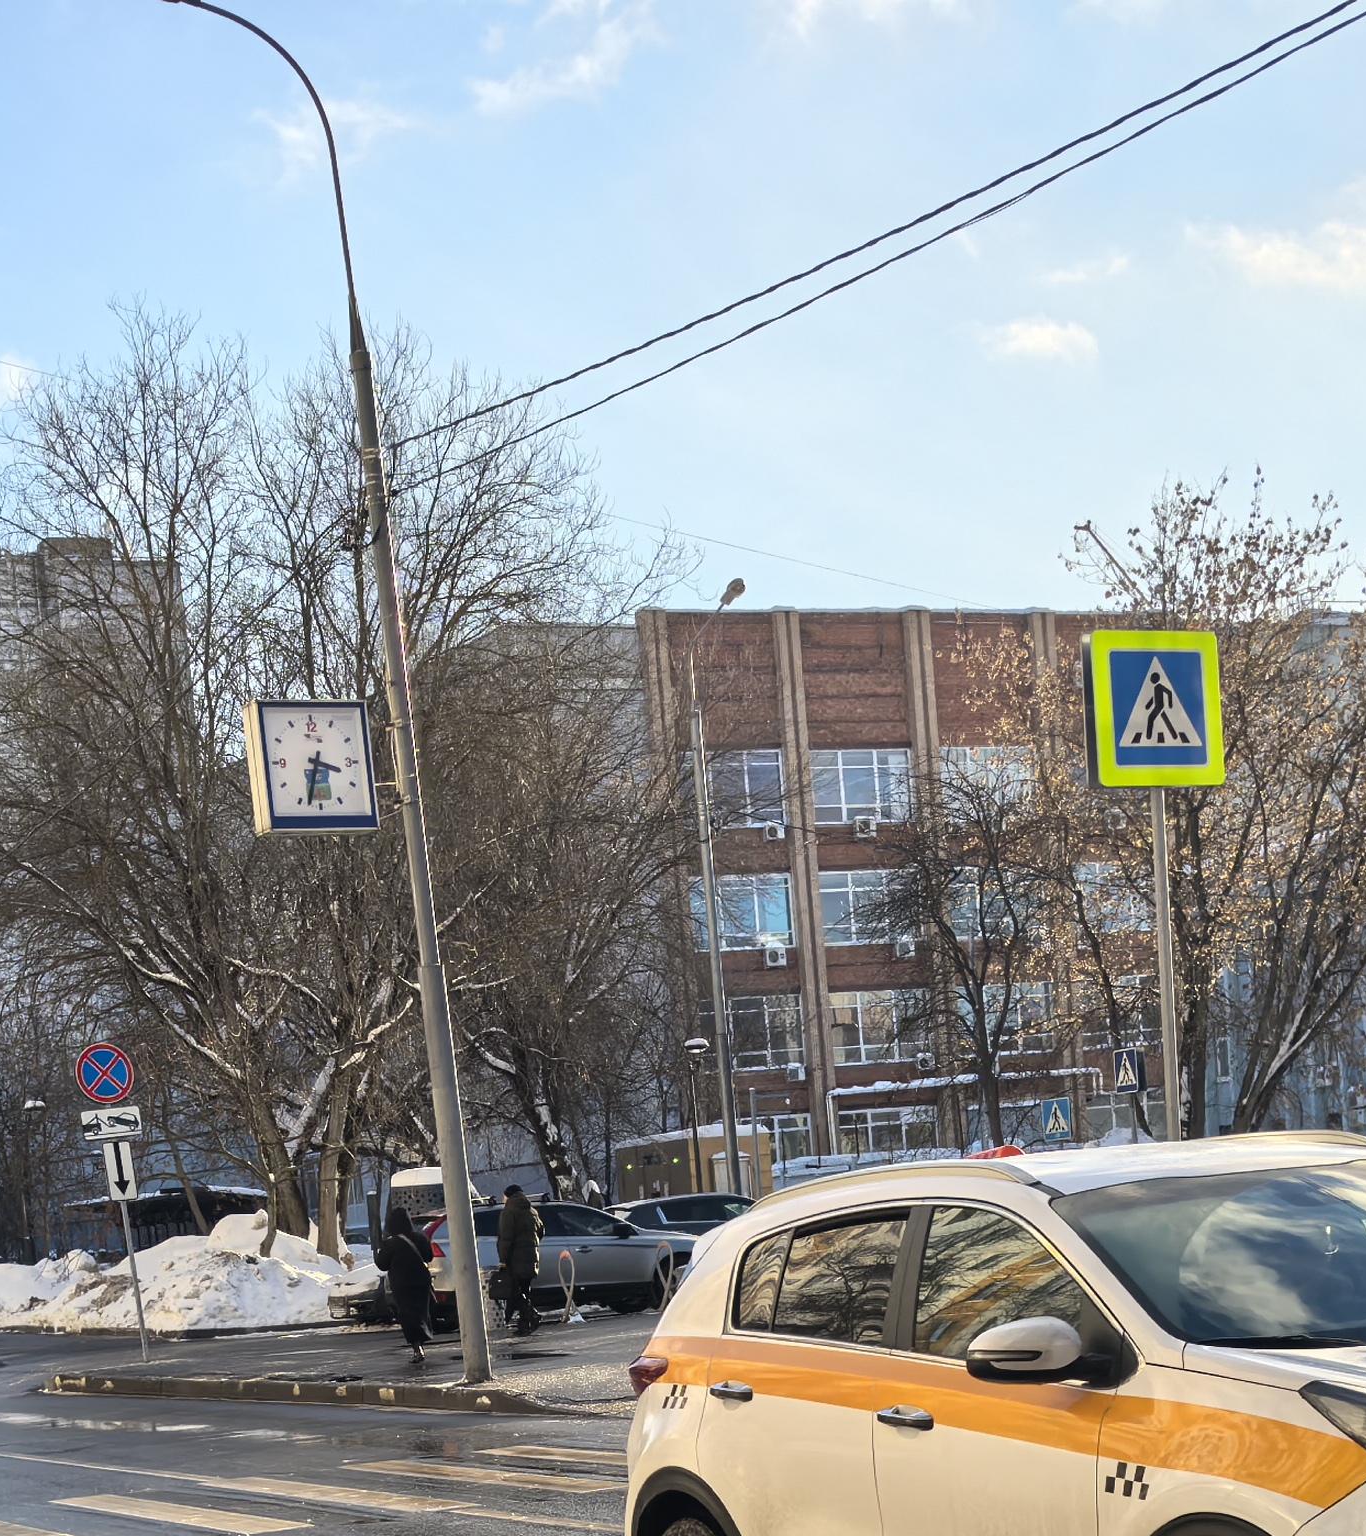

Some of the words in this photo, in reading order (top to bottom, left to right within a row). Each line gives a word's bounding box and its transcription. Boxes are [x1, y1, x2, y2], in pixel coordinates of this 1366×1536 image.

[305, 722, 317, 732] 12
[279, 758, 286, 768] 9
[344, 756, 353, 768] 3
